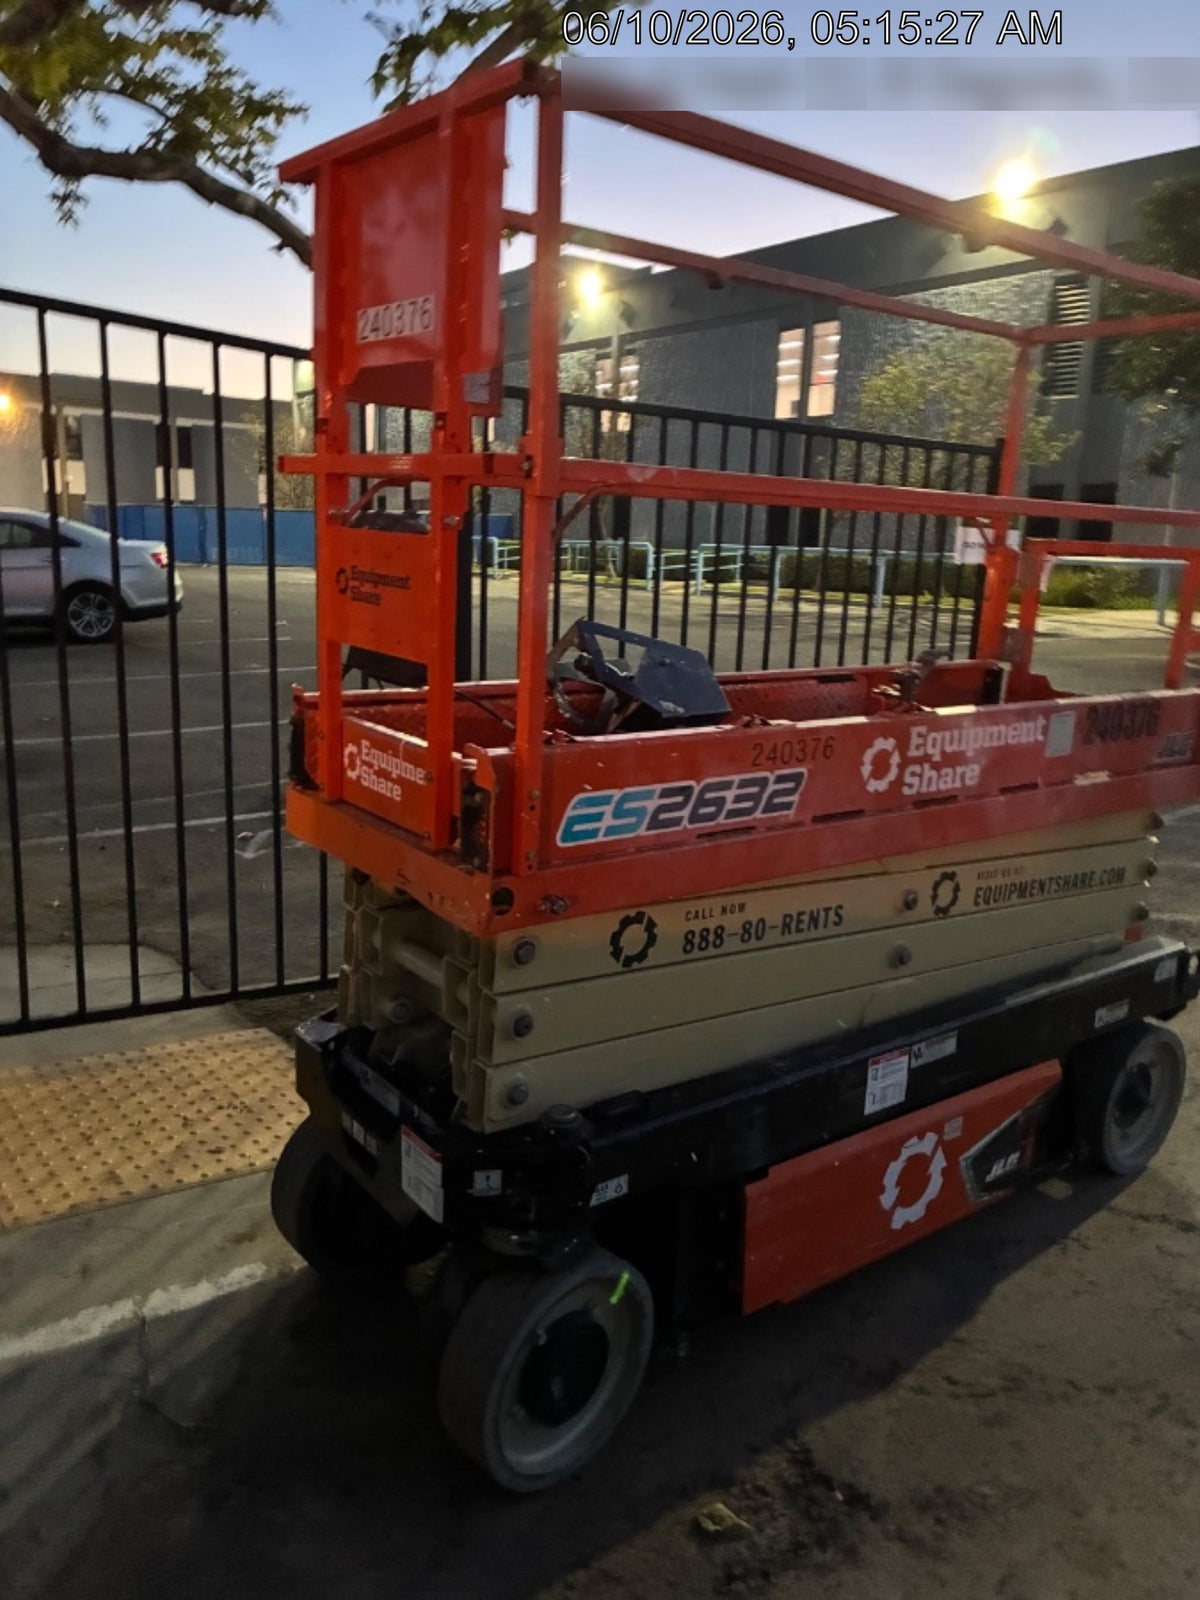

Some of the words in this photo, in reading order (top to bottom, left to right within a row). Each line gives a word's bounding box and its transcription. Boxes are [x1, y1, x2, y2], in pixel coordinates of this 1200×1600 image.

[360, 297, 431, 340] 240376
[752, 736, 835, 767] 240376
[907, 715, 1047, 761] Equipment
[361, 739, 427, 786] Equipme
[361, 765, 402, 801] Share
[902, 763, 980, 796] Share
[557, 768, 807, 847] ES2632
[973, 866, 1127, 907] EQUIPMENTSHARE.COM
[682, 904, 844, 954] 888-80-RENTS
[685, 908, 715, 922] CALL
[721, 902, 747, 916] NOW
